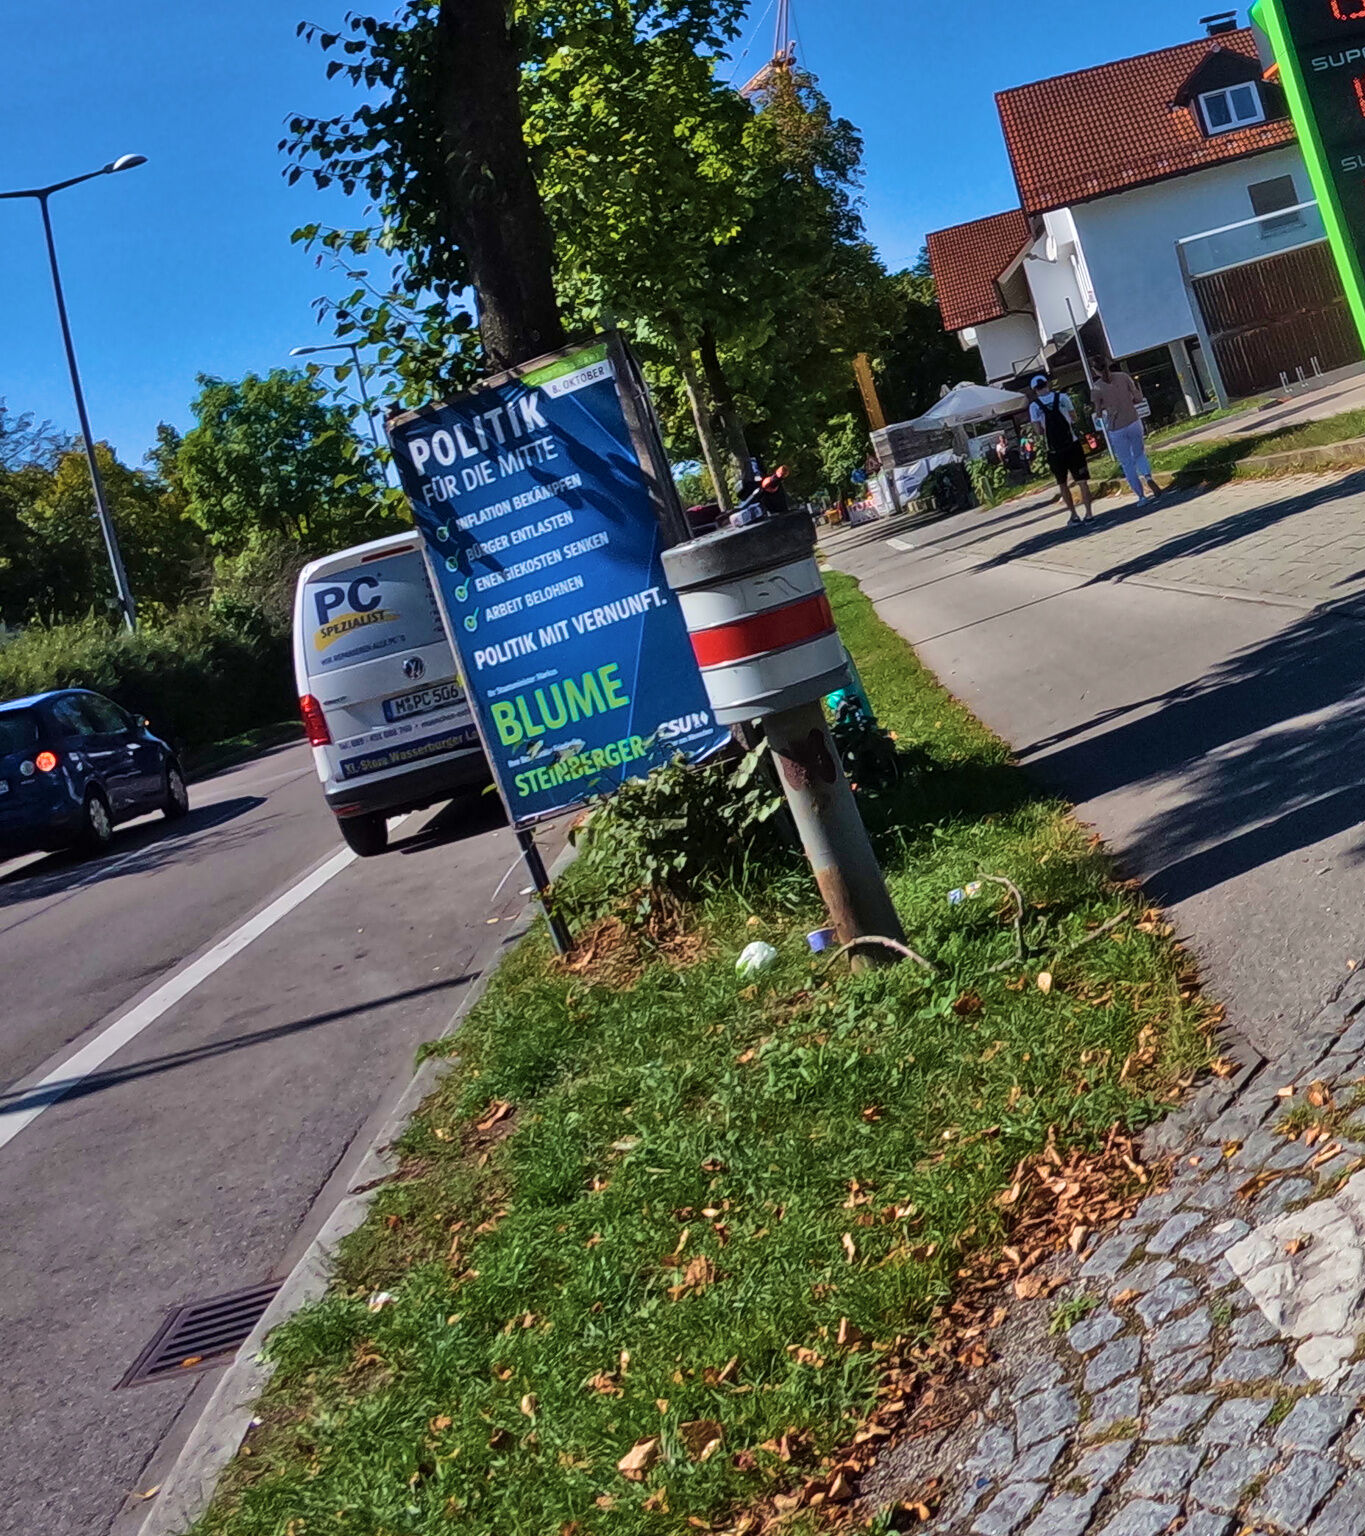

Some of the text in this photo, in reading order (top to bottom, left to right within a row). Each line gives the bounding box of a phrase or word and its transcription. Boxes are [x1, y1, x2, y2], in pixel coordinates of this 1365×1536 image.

[562, 366, 605, 390] OKTOBER
[408, 391, 549, 476] POLITIK
[422, 435, 559, 507] FÜR DIE MITTE
[456, 473, 583, 532] INFLATION BEKÄMPFEN
[466, 511, 575, 562] BÜRGER ENTLASTEN
[475, 531, 610, 592] ENERGIEKOSTEN SENKEN
[313, 576, 383, 626] PC
[320, 609, 387, 639] SPEZIALIST
[485, 575, 585, 622] ARBEIT BELOHNEN
[473, 586, 669, 671] POLITIK MIT VERNUNFT.
[395, 699, 406, 714] M
[413, 692, 432, 710] PC
[490, 663, 631, 747] BLUME
[389, 735, 464, 764] Wasserburger
[465, 729, 480, 742] La
[515, 734, 647, 798] STEINBERGER
